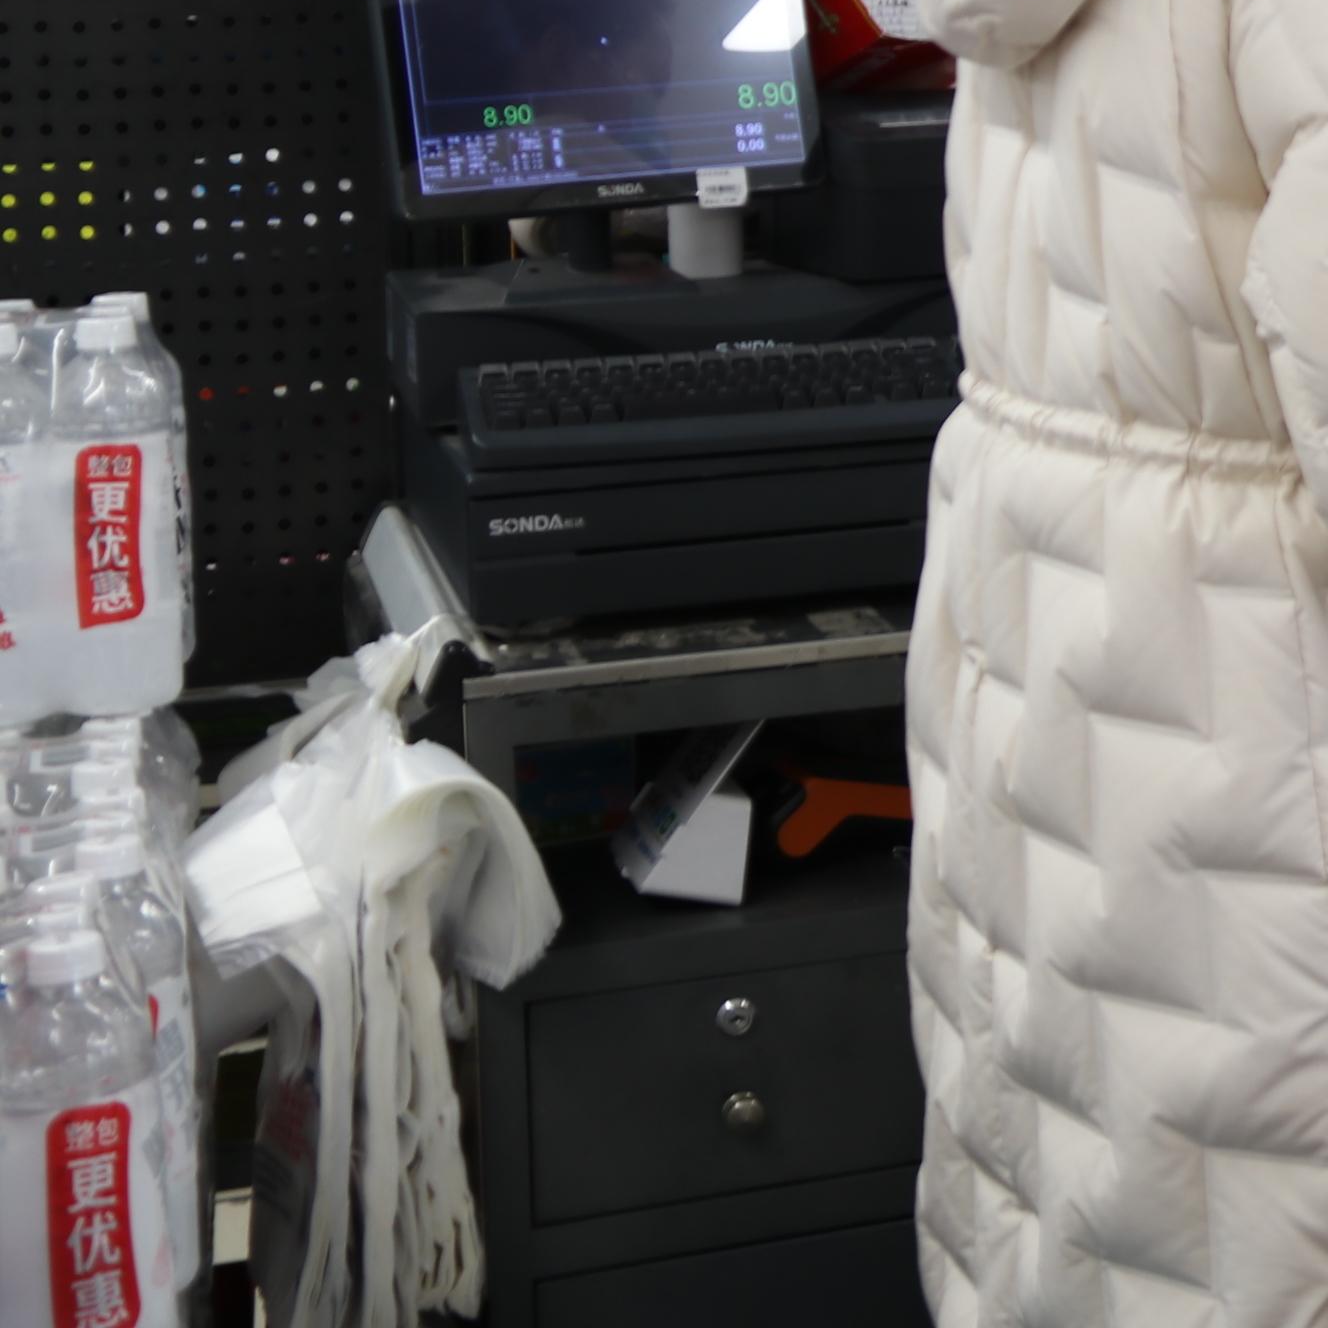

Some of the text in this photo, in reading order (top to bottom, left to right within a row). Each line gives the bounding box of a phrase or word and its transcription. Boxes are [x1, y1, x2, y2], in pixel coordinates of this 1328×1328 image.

[736, 79, 798, 111] 8.90
[483, 103, 534, 128] 8.90
[488, 513, 564, 537] SONDA
[86, 481, 135, 615] 更优惠
[65, 1152, 129, 1328] 更优惠
